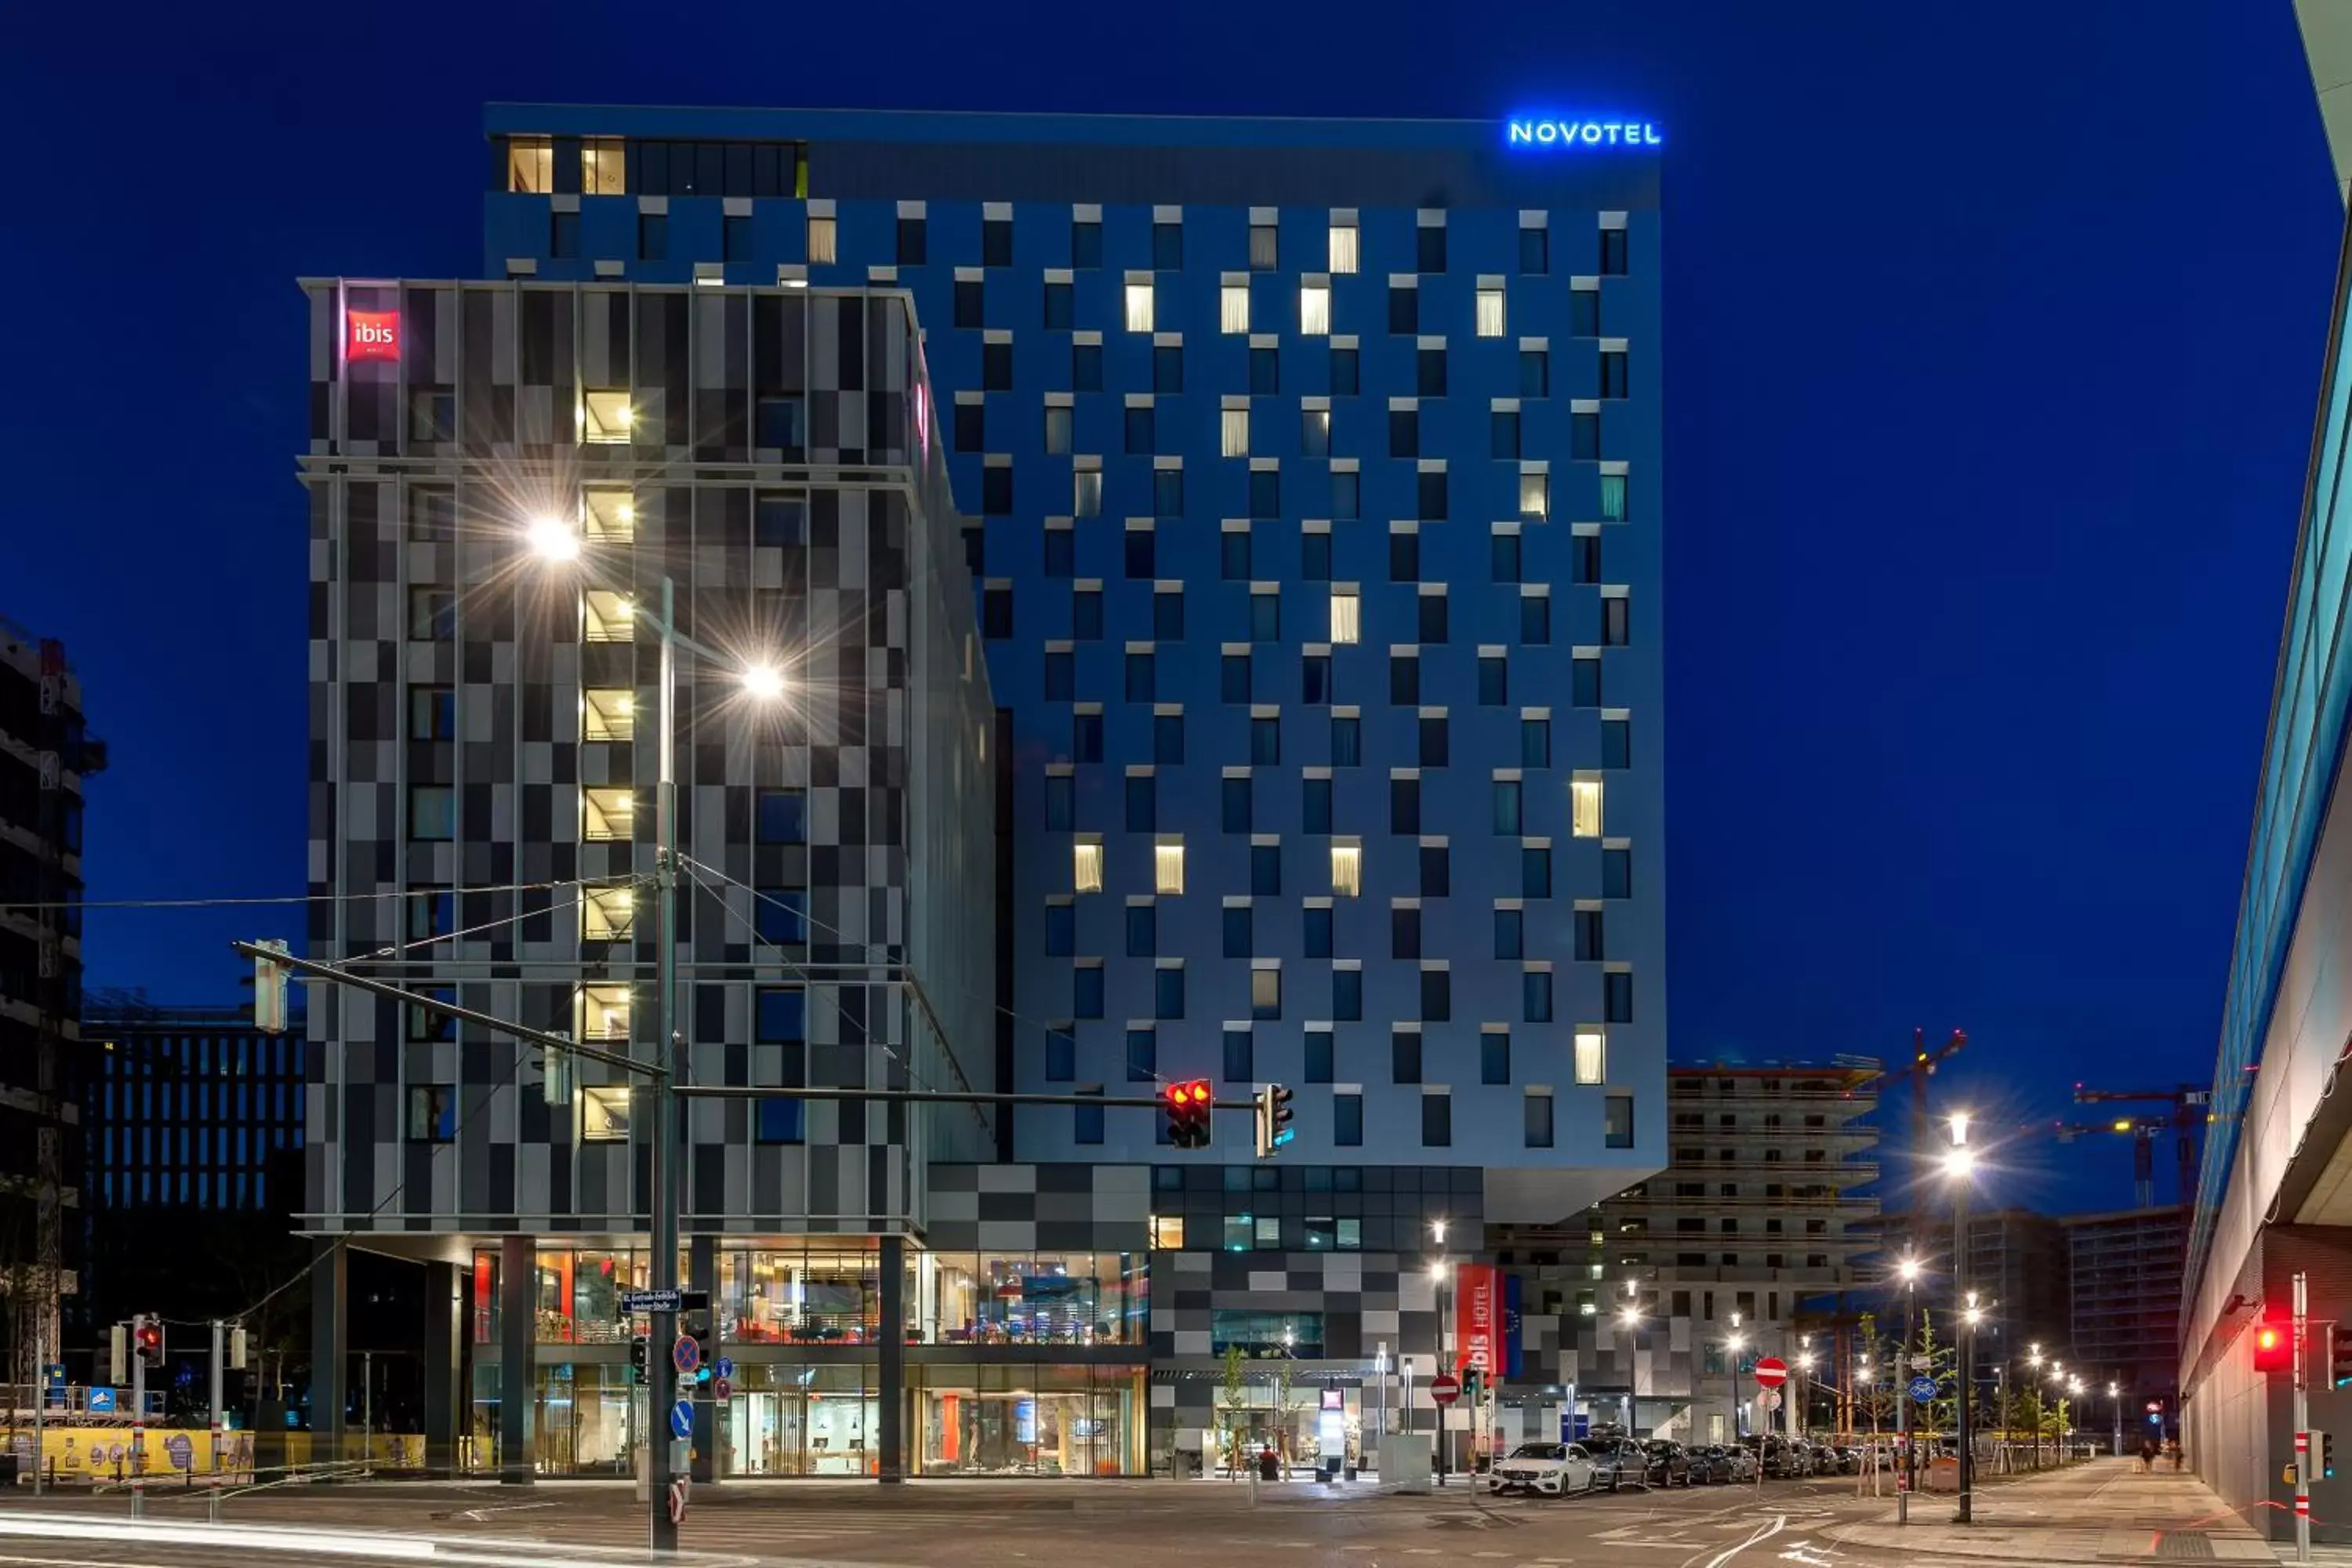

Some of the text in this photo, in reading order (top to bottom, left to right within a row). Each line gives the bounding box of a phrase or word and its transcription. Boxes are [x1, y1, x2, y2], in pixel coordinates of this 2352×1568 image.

[1511, 123, 1661, 144] NOVOTEL
[355, 322, 393, 343] ibis
[1468, 1283, 1489, 1371] ibis HOTEL
